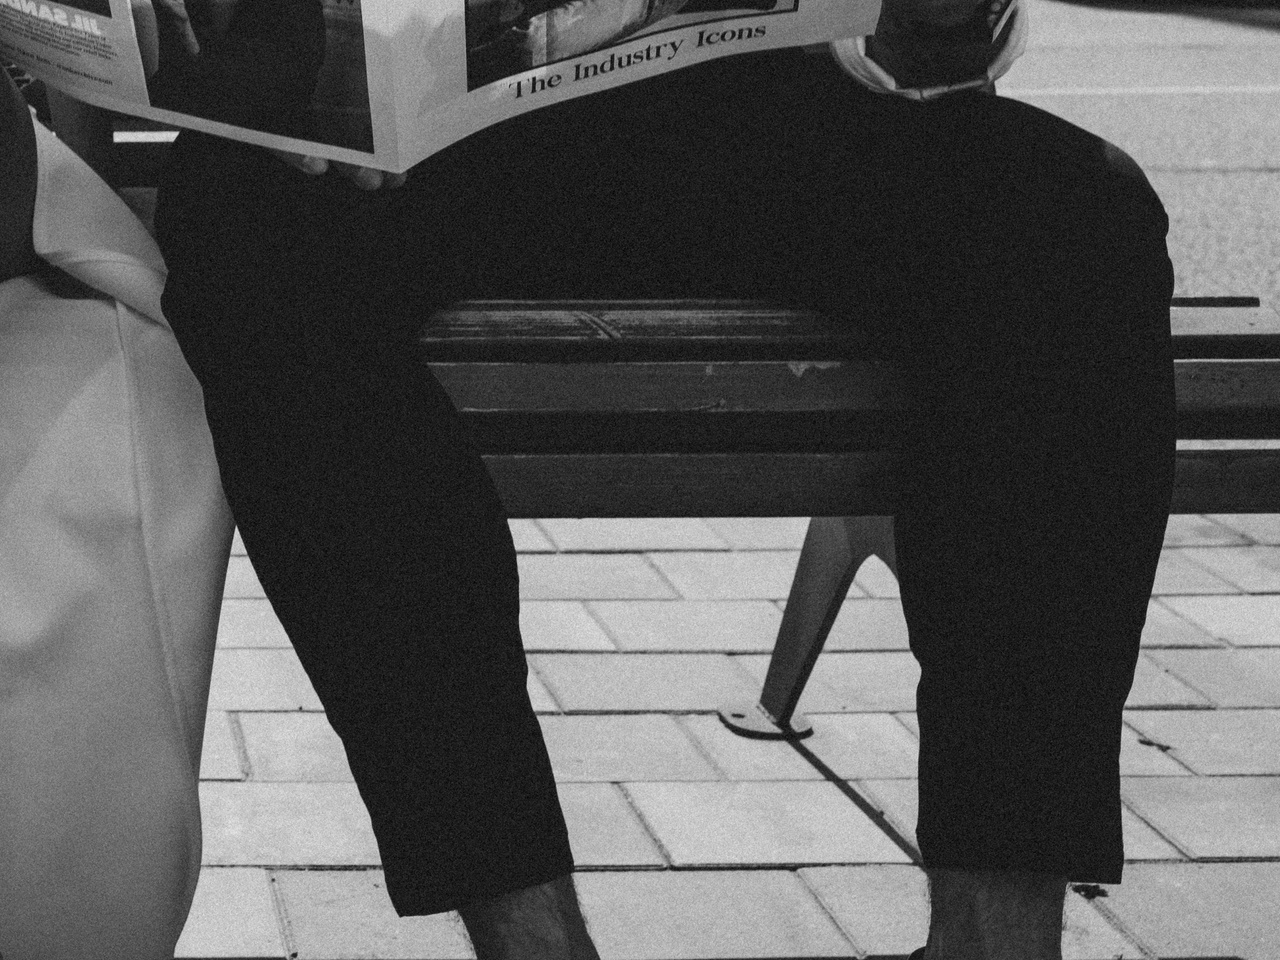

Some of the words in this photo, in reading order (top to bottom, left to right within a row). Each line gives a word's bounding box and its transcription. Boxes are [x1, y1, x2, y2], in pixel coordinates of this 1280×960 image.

[508, 74, 562, 100] The
[573, 38, 685, 83] Industry
[695, 24, 768, 49] Icons
